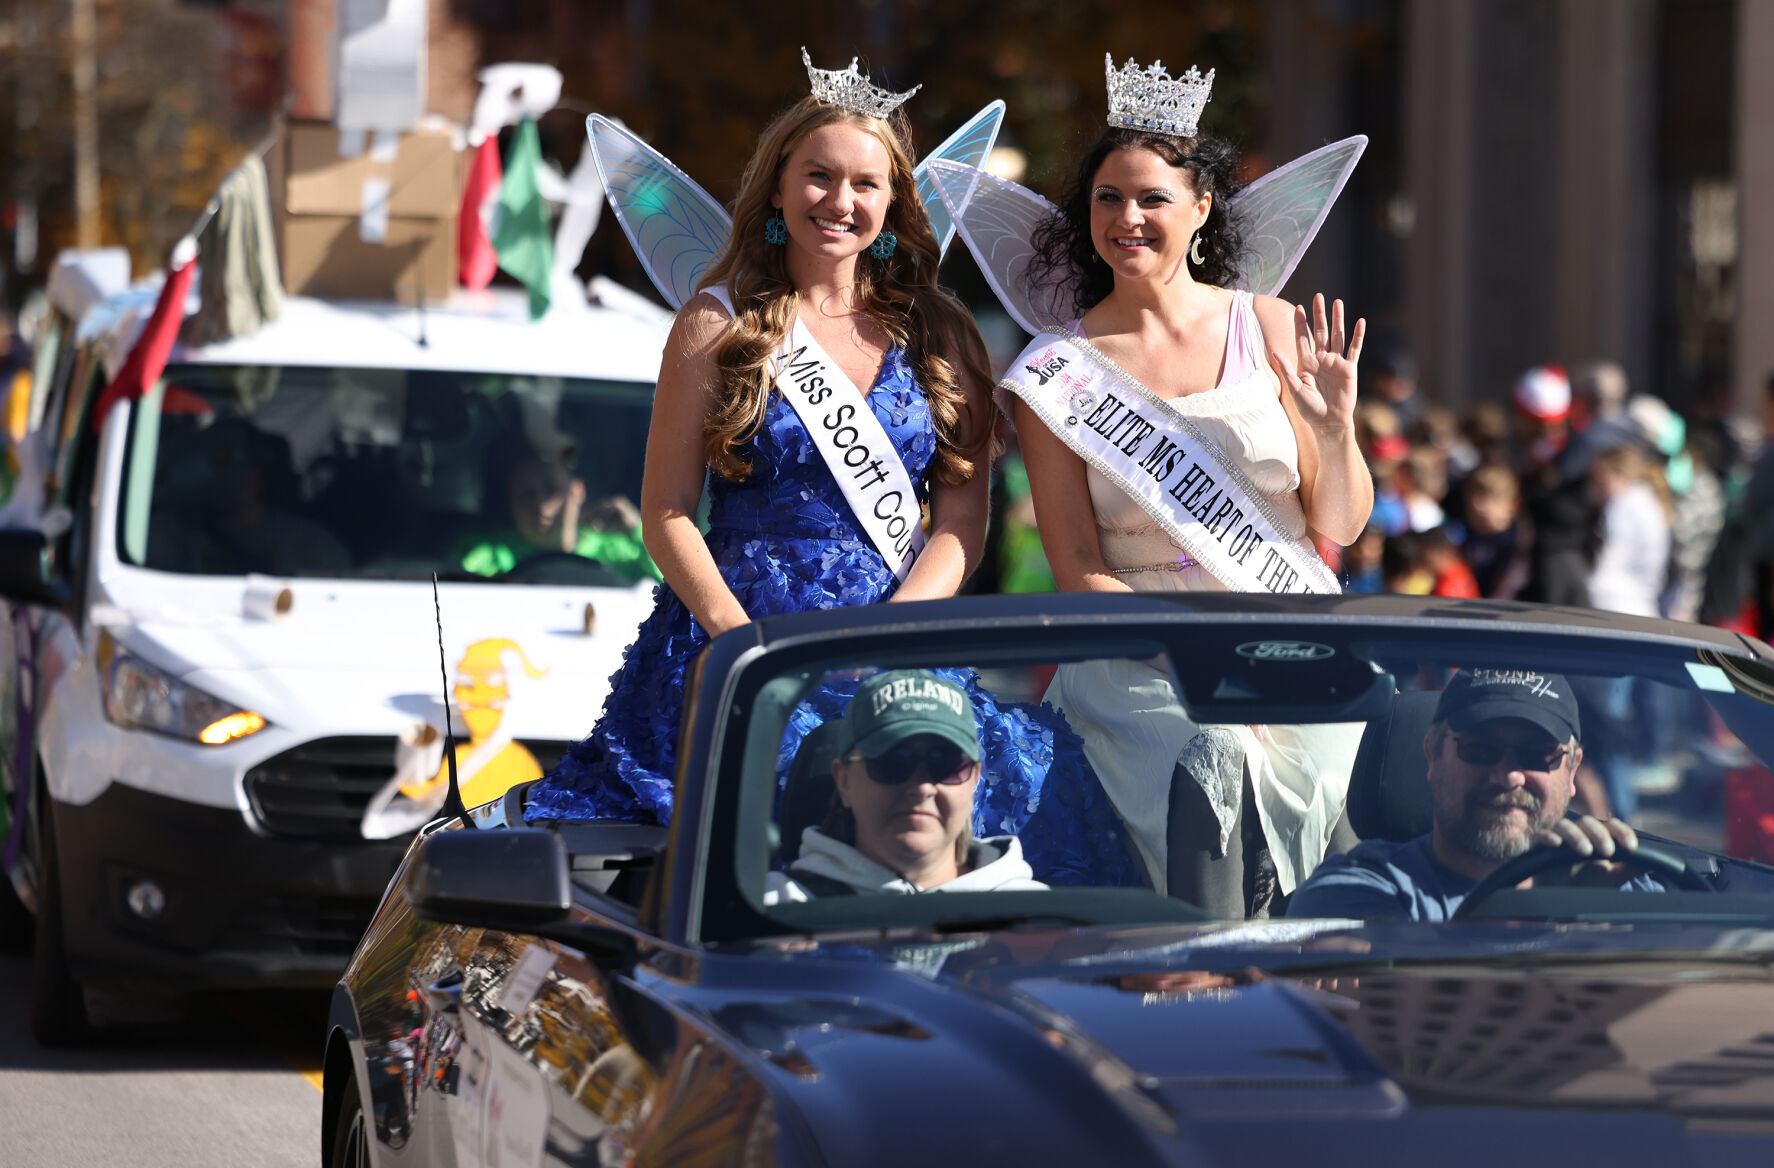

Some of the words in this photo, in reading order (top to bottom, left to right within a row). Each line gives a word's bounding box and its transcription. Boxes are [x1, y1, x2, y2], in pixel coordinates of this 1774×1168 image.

[1041, 356, 1070, 378] USA
[777, 345, 833, 405] Miss
[822, 404, 890, 490] Scott
[873, 490, 916, 573] Coun
[1083, 393, 1156, 457] ELITE
[1138, 435, 1188, 483] MS
[1168, 462, 1244, 544] HEART
[1228, 524, 1264, 566] OF
[1256, 546, 1299, 594] THE
[1254, 642, 1316, 658] Ford
[872, 677, 963, 716] IRELAND
